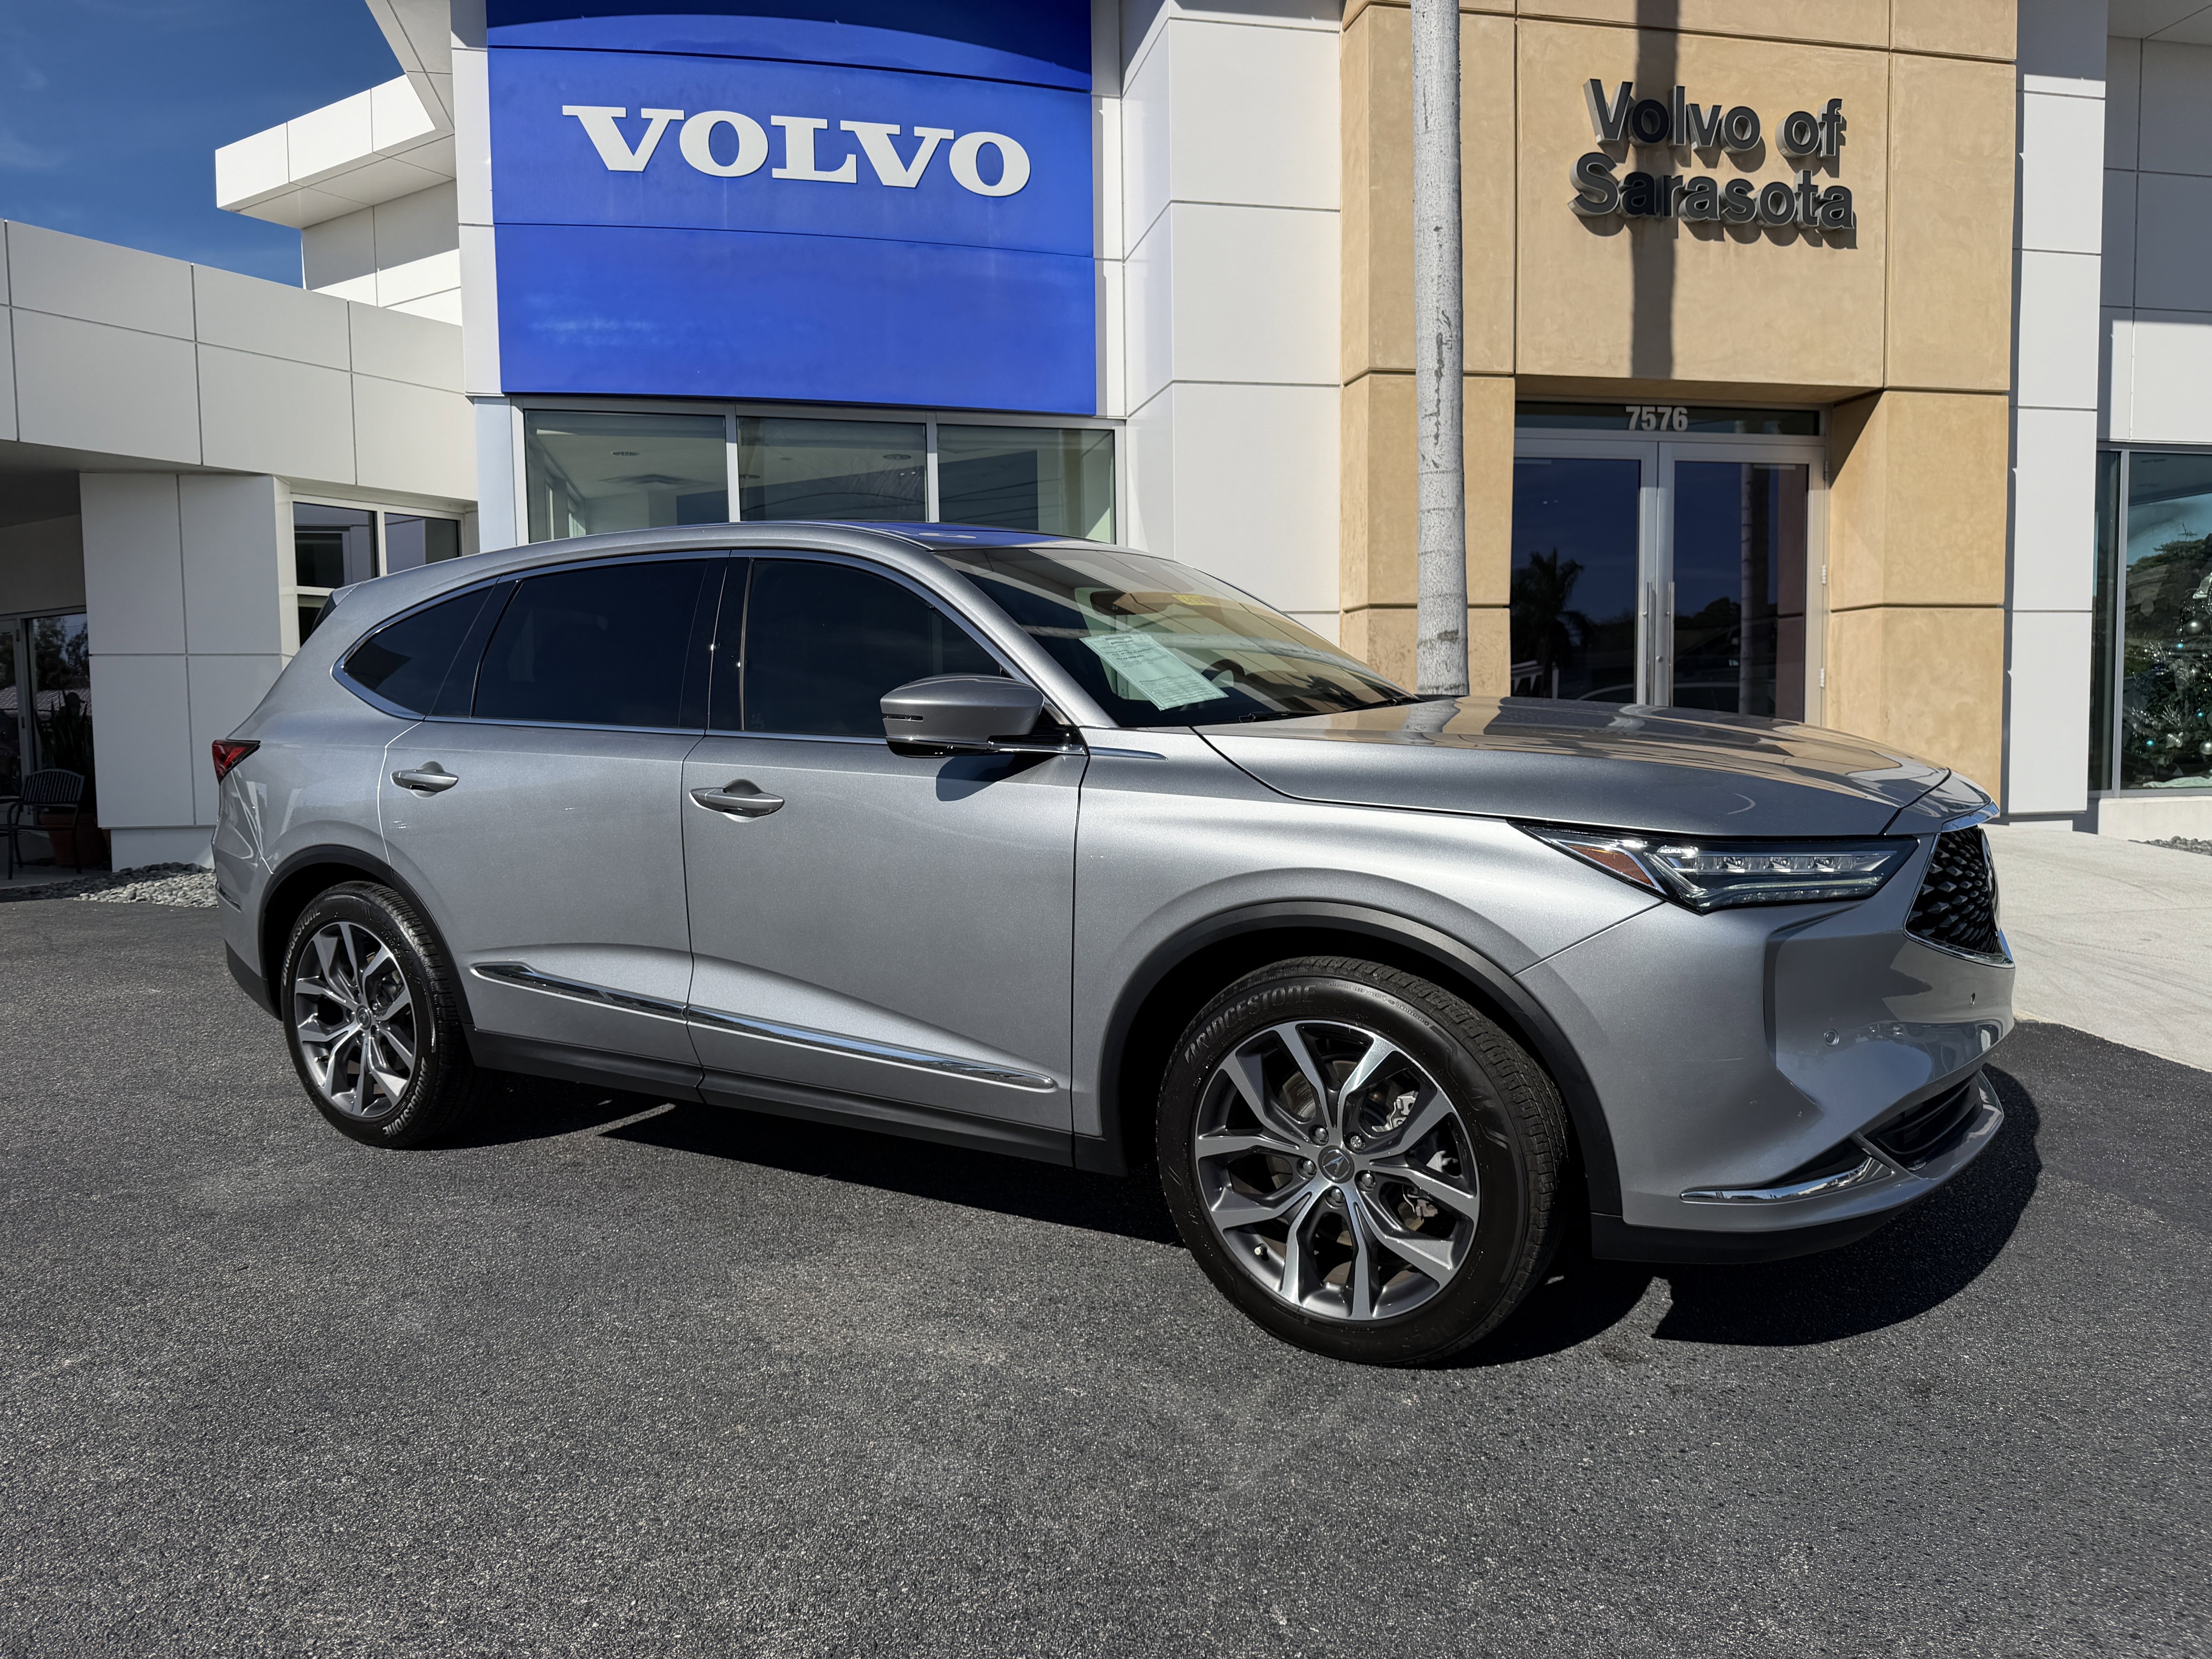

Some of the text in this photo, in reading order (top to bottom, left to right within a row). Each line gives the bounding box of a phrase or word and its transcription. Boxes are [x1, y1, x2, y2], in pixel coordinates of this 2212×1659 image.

[562, 105, 1030, 197] VOLVO
[1583, 79, 1843, 158] Volvo of
[1568, 152, 1855, 231] Sarasota
[1625, 406, 1688, 432] 7576
[1185, 984, 1316, 1063] BRIDGESTONE
